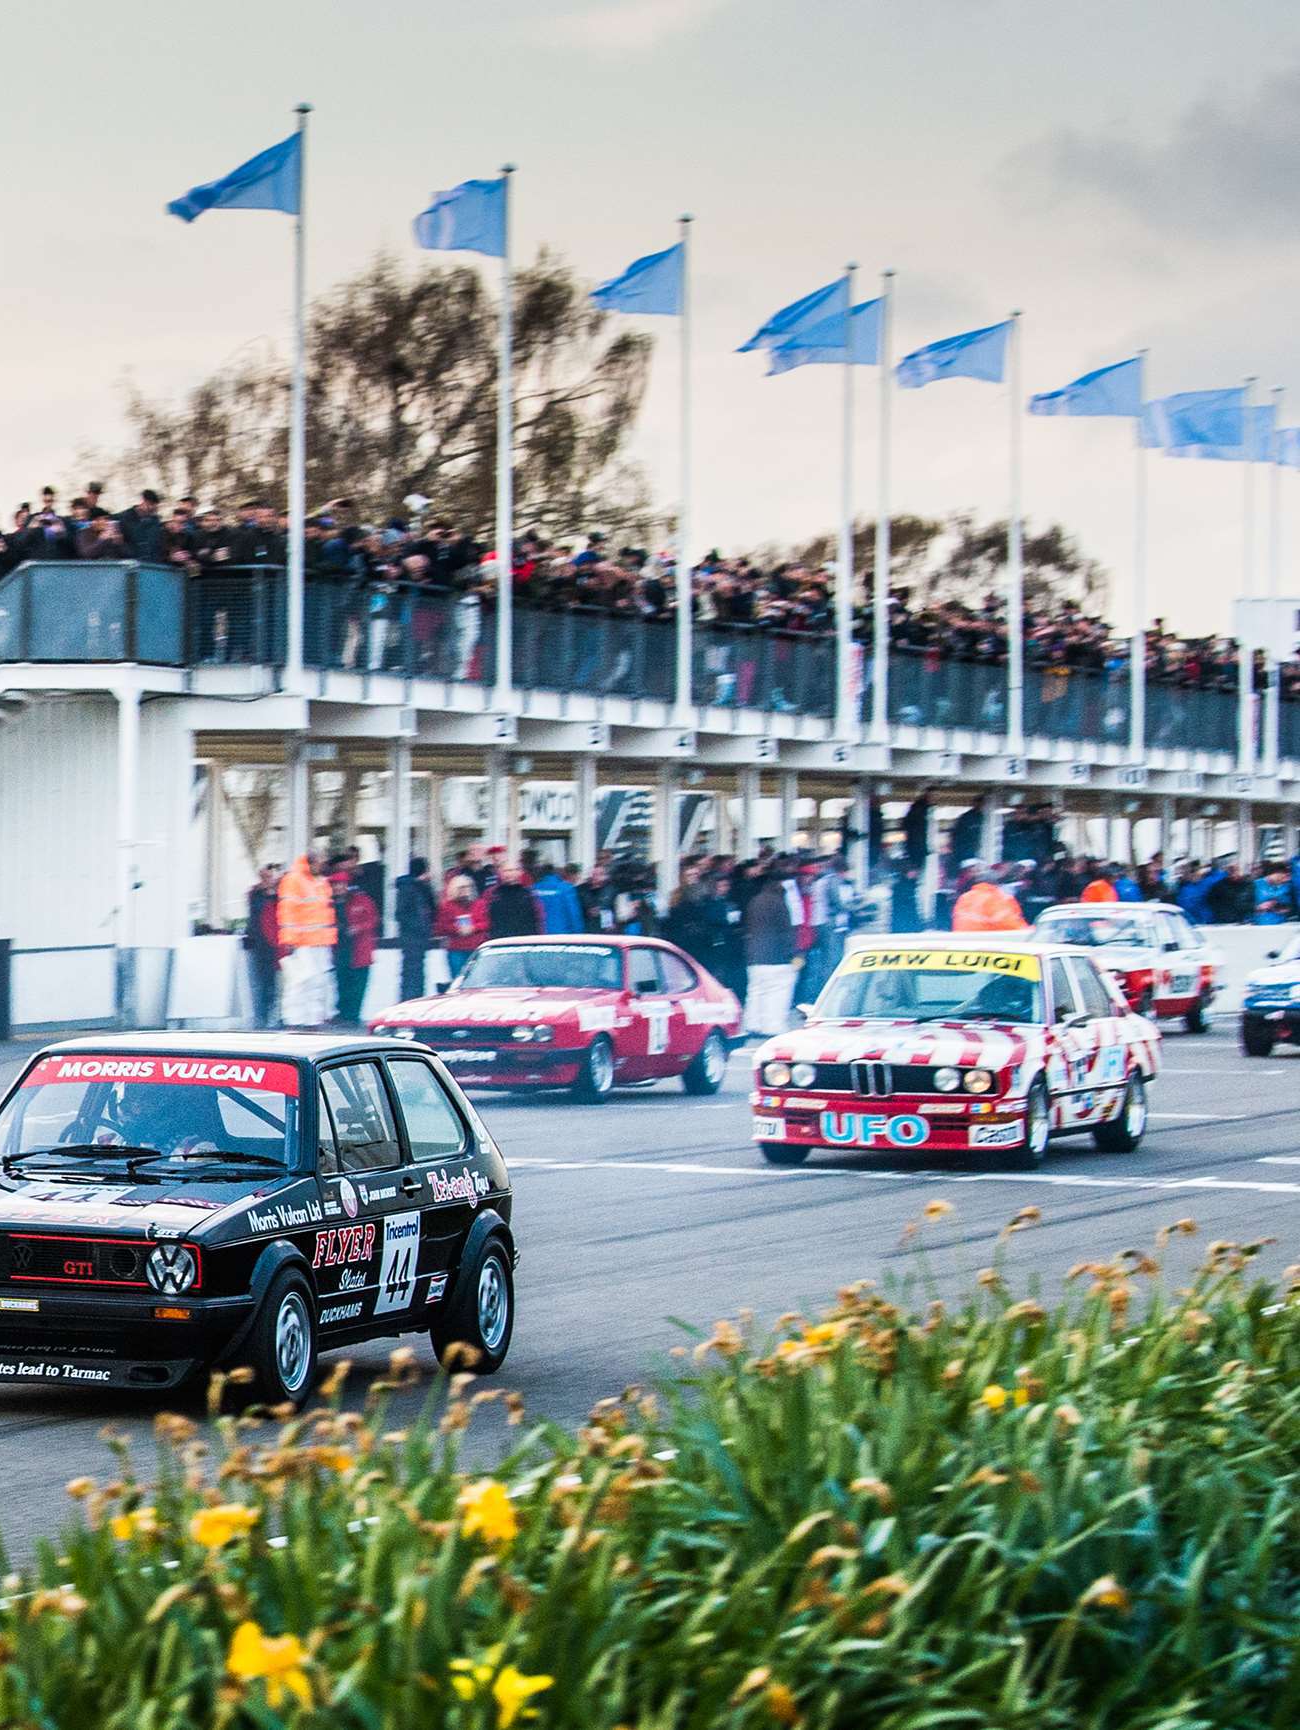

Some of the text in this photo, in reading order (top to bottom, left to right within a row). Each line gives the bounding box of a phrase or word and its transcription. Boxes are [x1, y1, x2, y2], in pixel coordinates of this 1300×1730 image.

[859, 953, 1022, 971] BMW LUIGI
[57, 1061, 266, 1084] MORRIS VULCAN
[819, 1110, 931, 1147] UFO
[247, 1206, 279, 1232] Morris
[275, 1204, 309, 1227] Vulcan
[306, 1200, 323, 1222] Ltd
[386, 1216, 419, 1241] Tricentrol
[312, 1223, 376, 1268] FLYER
[63, 1261, 93, 1276] GTI
[339, 1268, 366, 1290] Skates
[385, 1247, 412, 1304] 44
[319, 1302, 363, 1325] DUCKHAMS
[17, 1361, 44, 1376] lead
[46, 1364, 59, 1377] to
[62, 1364, 111, 1380] Tarmac
